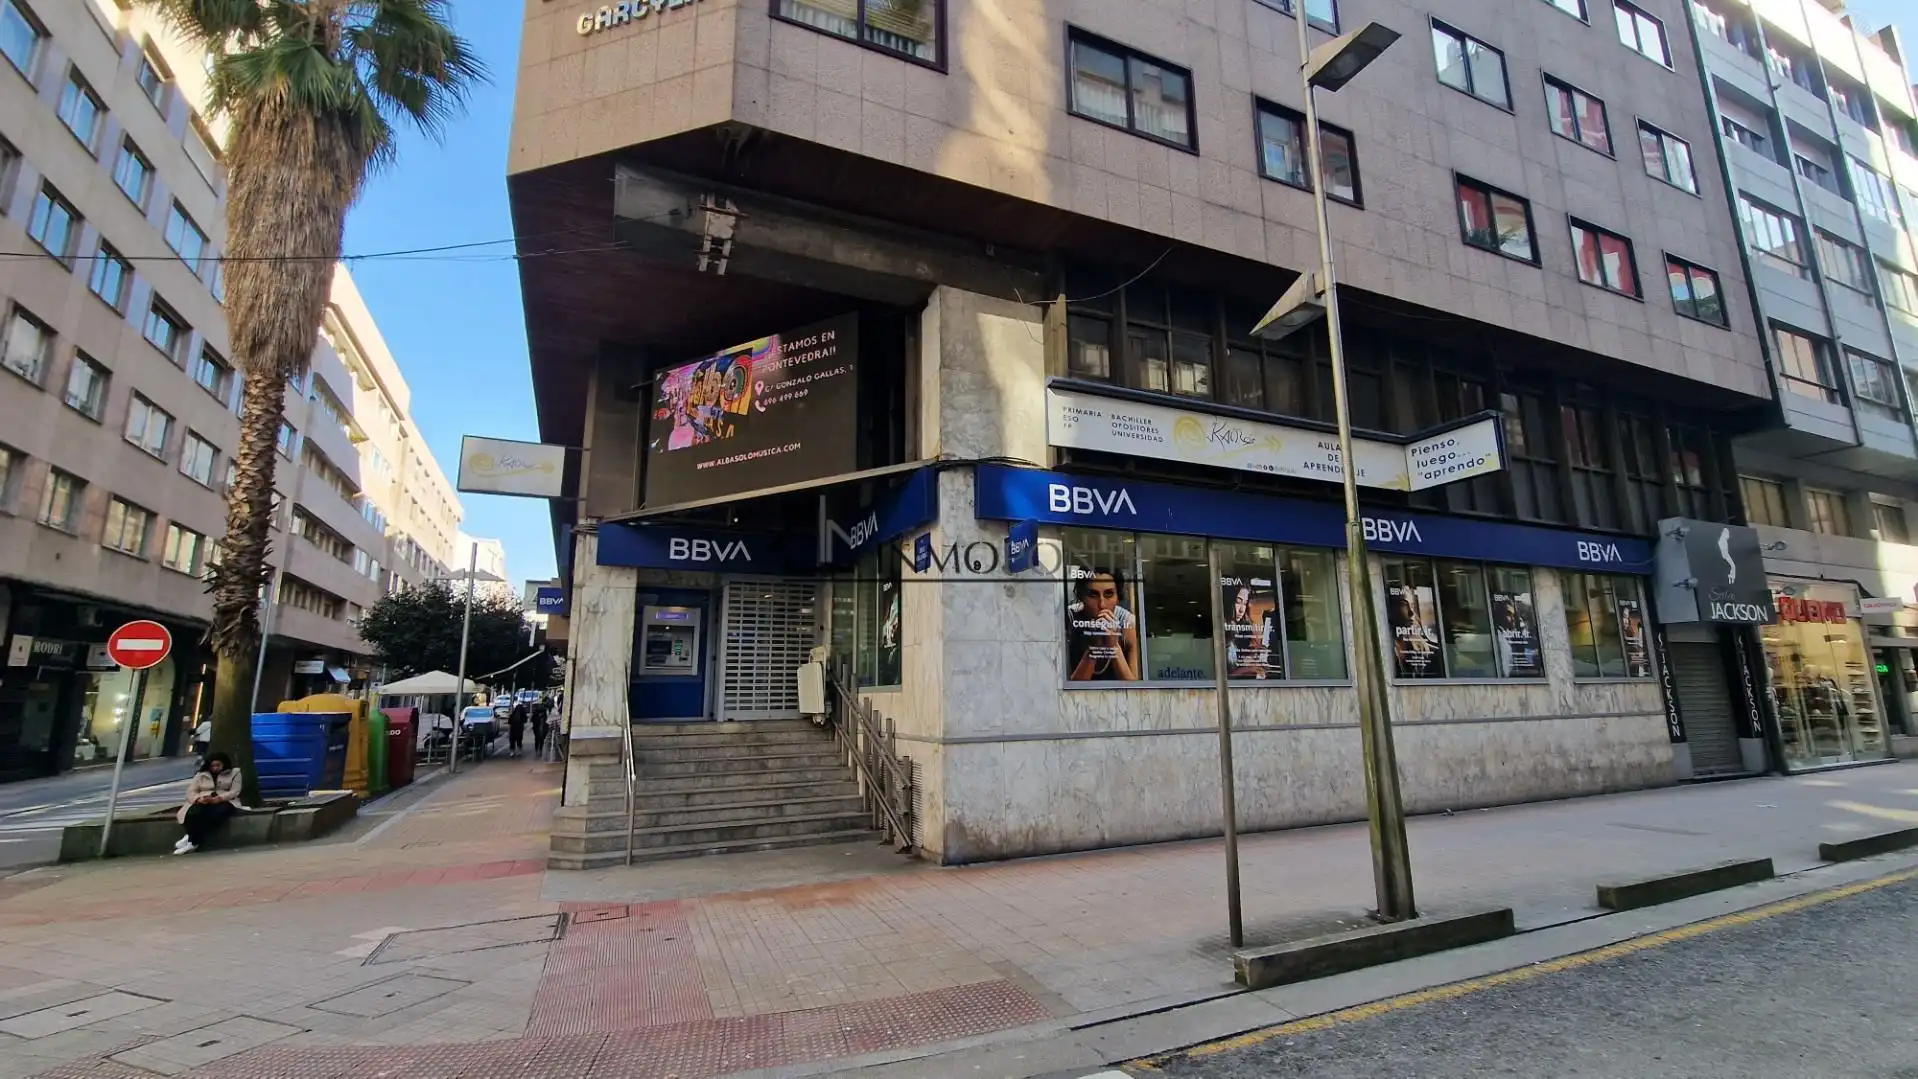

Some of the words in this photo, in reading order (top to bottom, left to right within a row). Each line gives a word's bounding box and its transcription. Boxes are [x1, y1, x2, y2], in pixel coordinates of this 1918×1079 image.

[821, 330, 836, 343] EN
[775, 375, 812, 390] GONZALO
[1062, 406, 1102, 418] PRIMARIA
[1063, 414, 1079, 422] ESO
[1111, 413, 1152, 425] BACHILLER
[1112, 422, 1160, 434] OPOSITORES
[1112, 430, 1164, 443] UNIVERSIDAD
[1317, 441, 1341, 451] AULA
[697, 442, 801, 470] WWW.ALBASOLOMUSICA.COM
[1327, 454, 1340, 463] DE
[1049, 483, 1137, 516] BBVA
[850, 512, 878, 550] BBVA
[1362, 517, 1422, 543] BBVA
[669, 537, 751, 562] BBVA
[1577, 541, 1622, 562] BBVA
[1070, 570, 1096, 579] BBVA
[1220, 577, 1243, 586] BBVA
[539, 597, 564, 605] BBVA
[1711, 602, 1768, 621] JACKSON
[1157, 666, 1207, 679] adelante.
[1661, 654, 1680, 737] JACKSON
[1741, 653, 1762, 732] JACKSON
